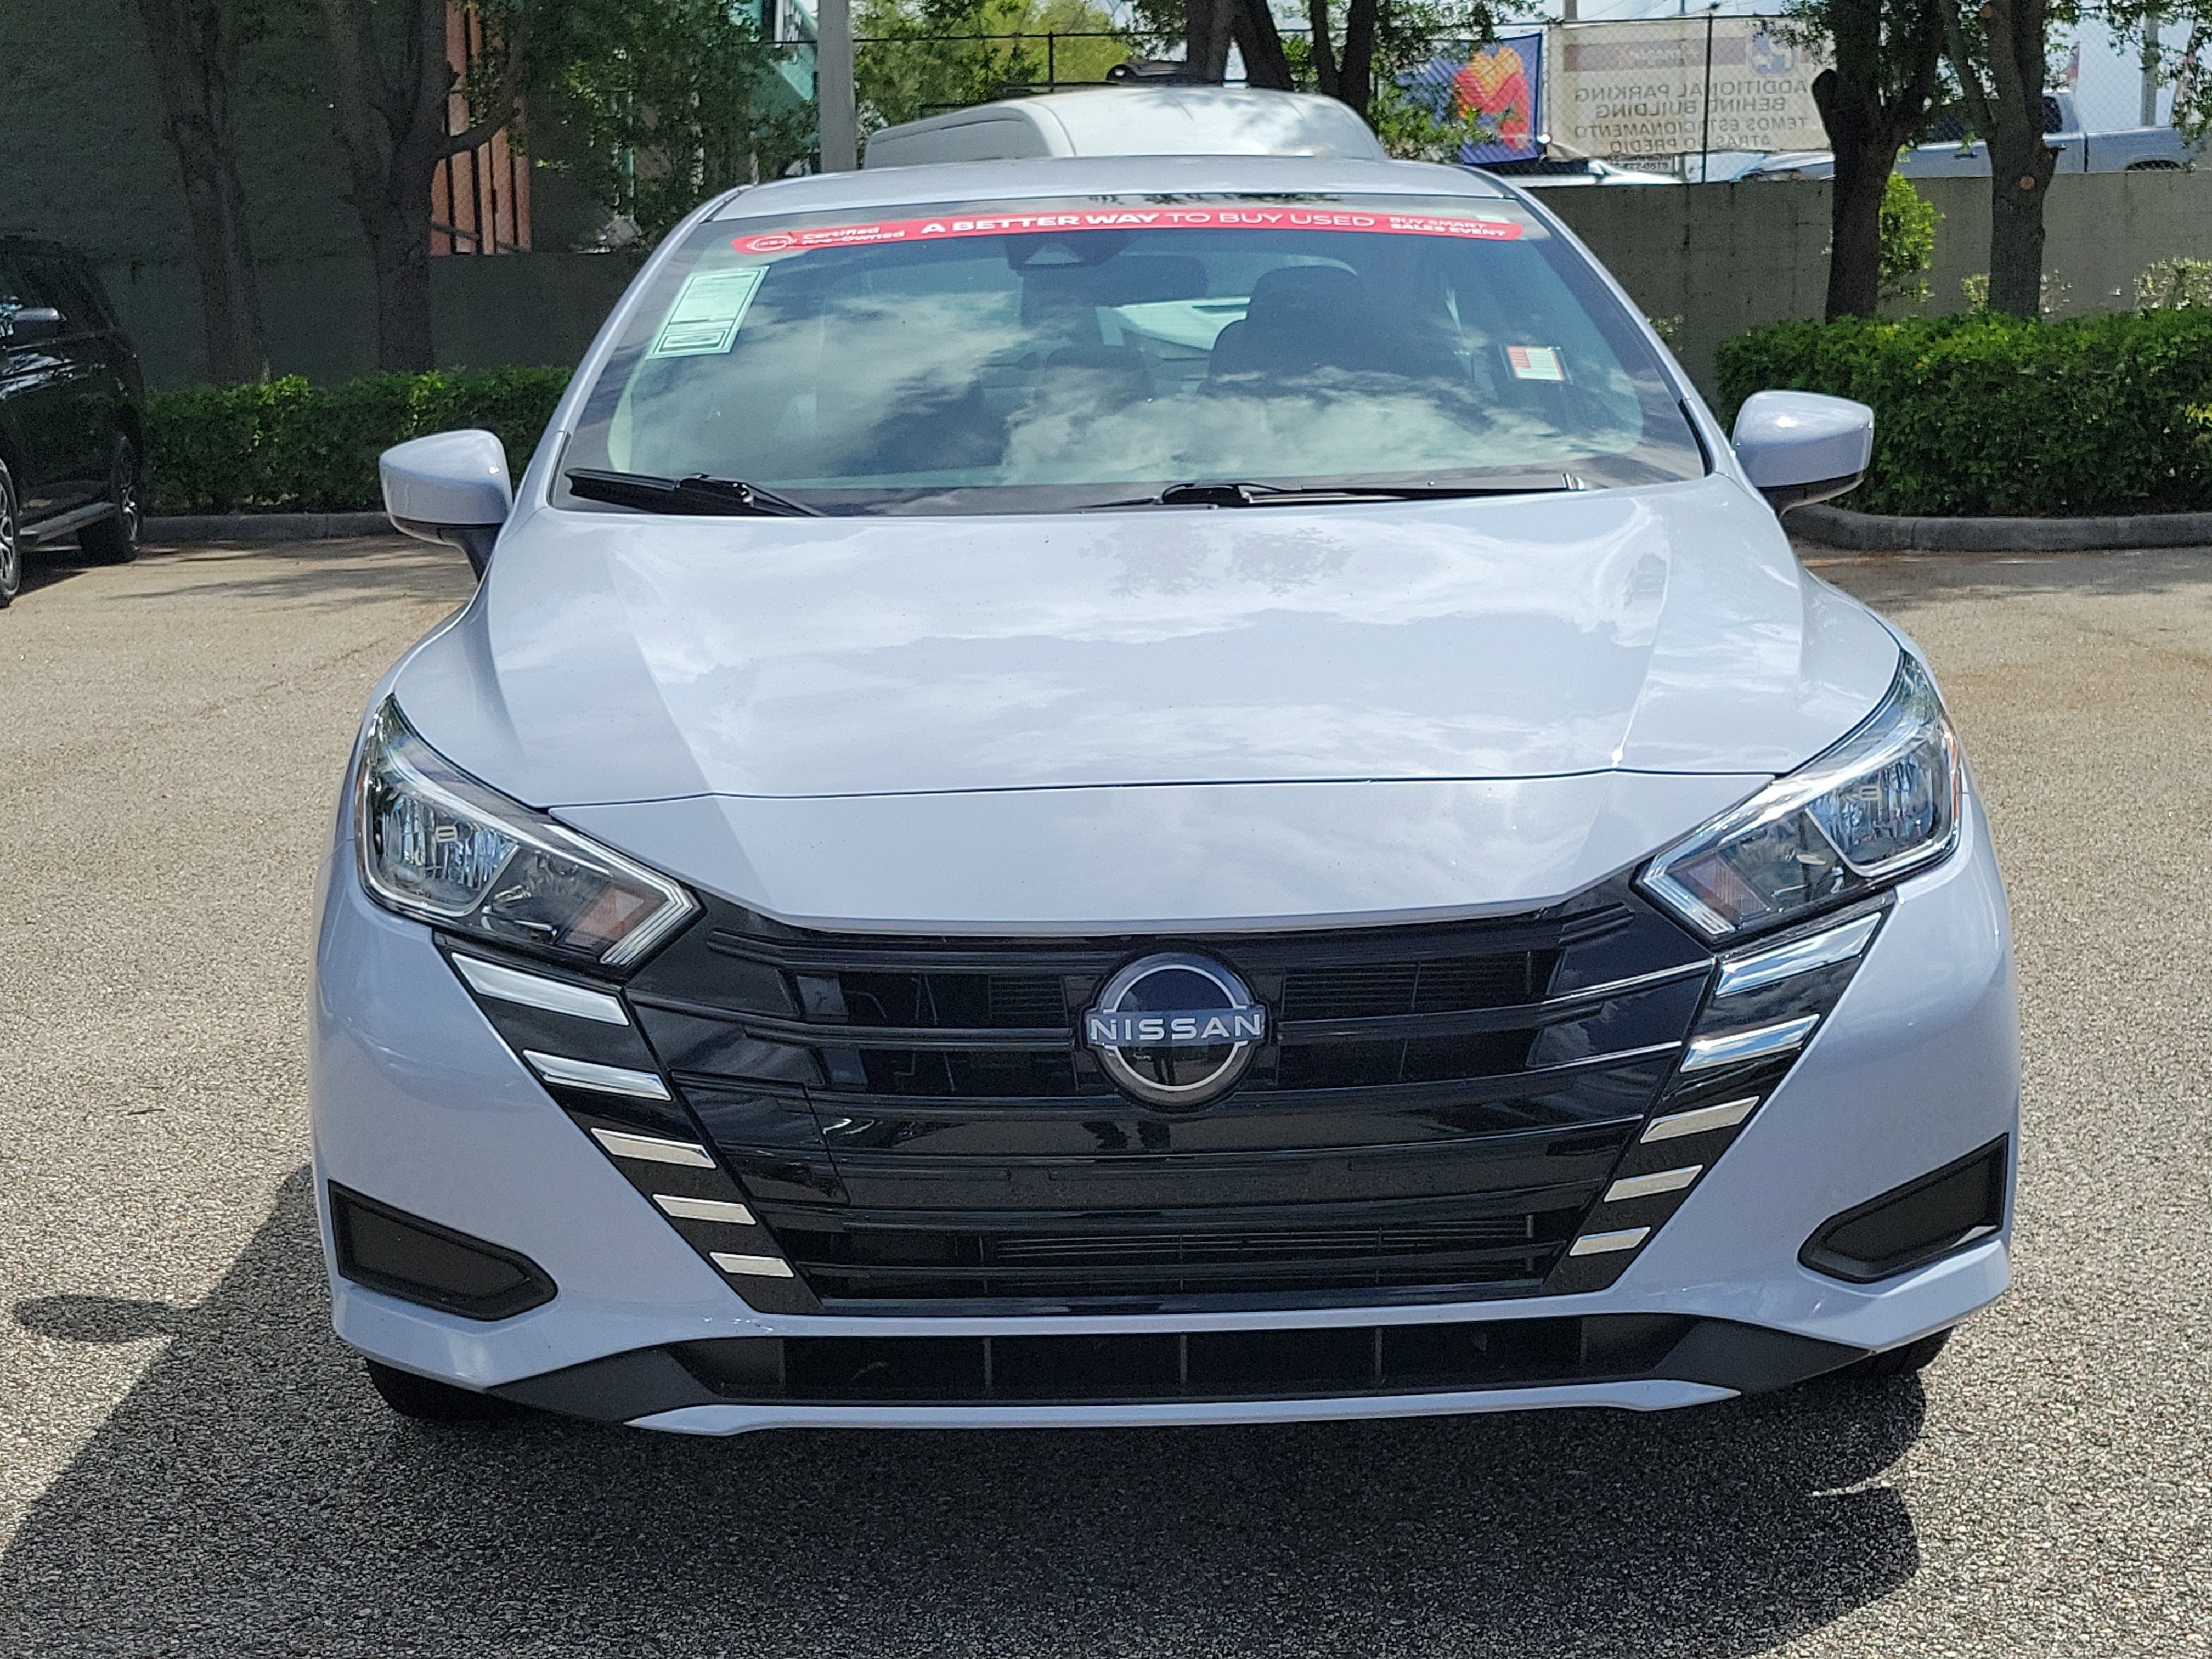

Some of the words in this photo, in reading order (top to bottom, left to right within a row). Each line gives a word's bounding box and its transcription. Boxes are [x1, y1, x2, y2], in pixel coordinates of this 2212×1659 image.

[921, 223, 946, 234] A
[952, 216, 1080, 232] BETTER
[1085, 213, 1159, 224] WAY
[1164, 213, 1211, 223] TO
[1219, 213, 1283, 224] BUY
[1290, 213, 1375, 227] USED
[1389, 217, 1425, 225] BUY
[803, 227, 879, 240] Certified
[1391, 223, 1446, 232] SALES
[1449, 226, 1506, 236] EVENT
[1090, 1014, 1261, 1040] NISSAN
